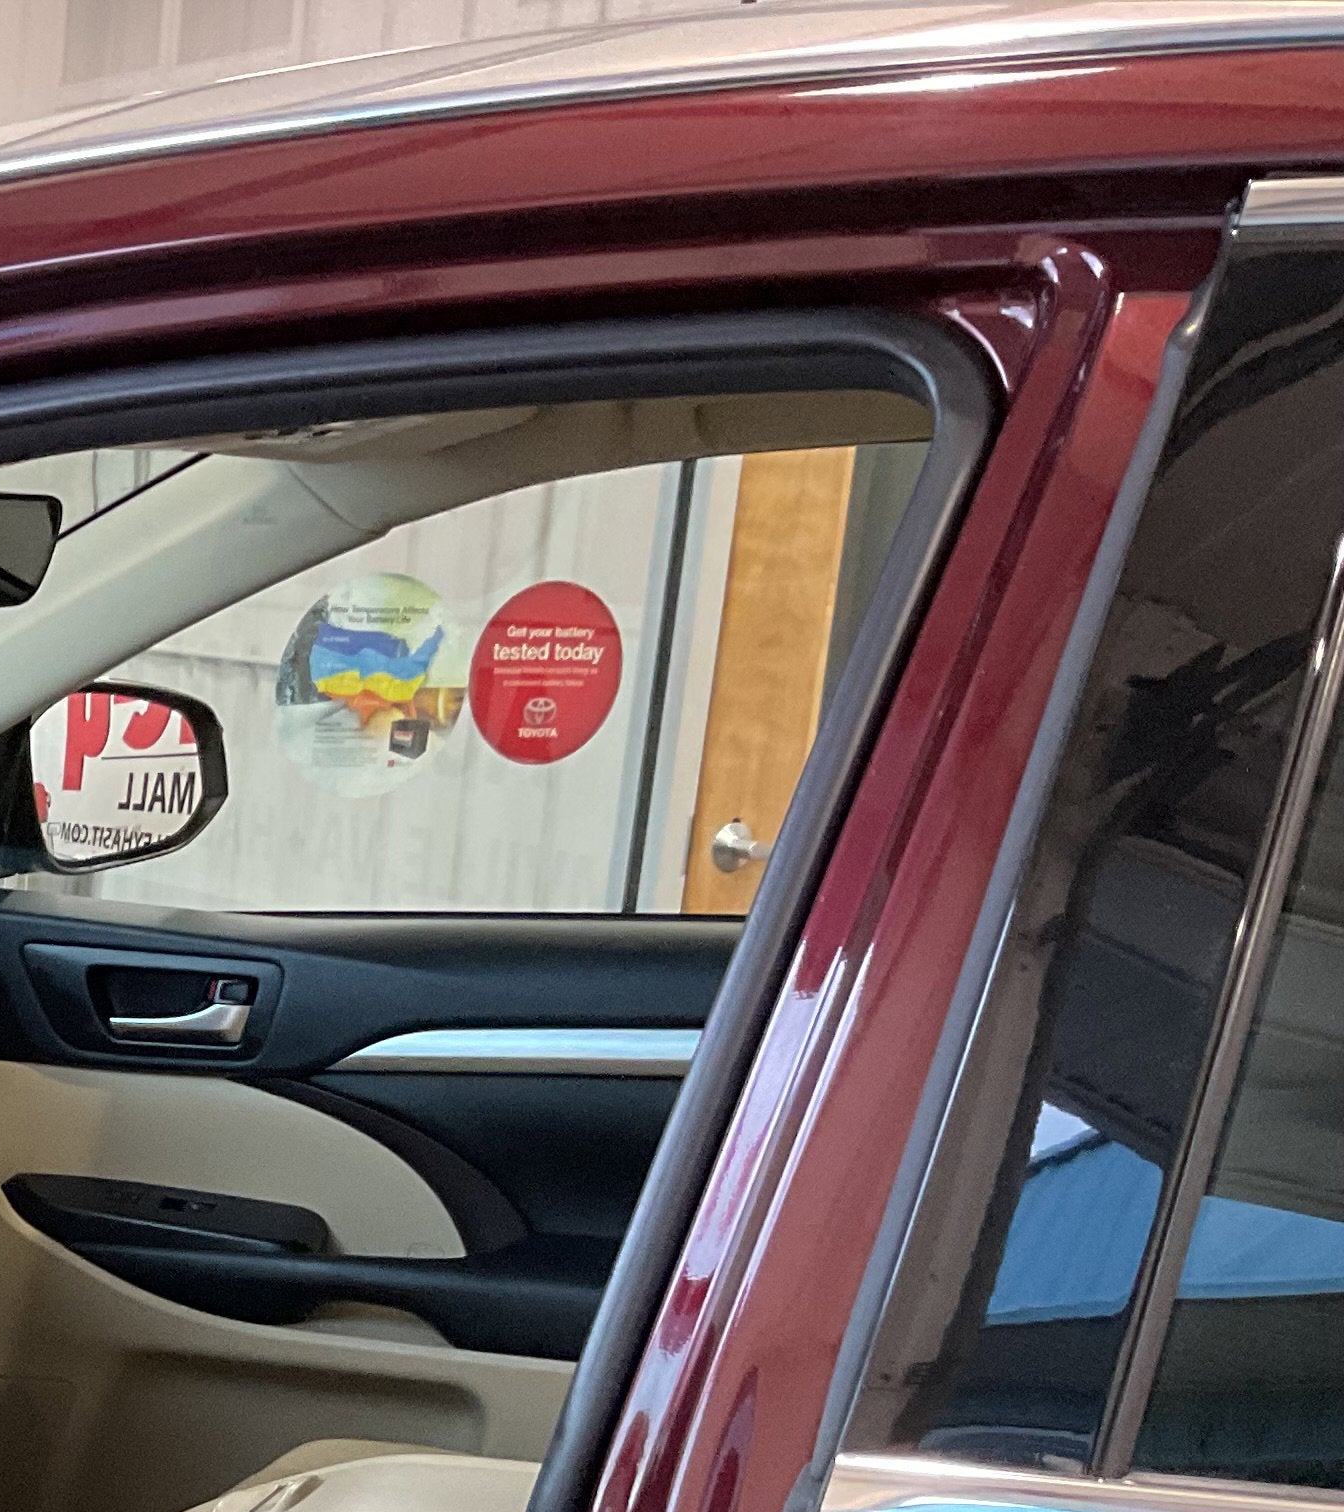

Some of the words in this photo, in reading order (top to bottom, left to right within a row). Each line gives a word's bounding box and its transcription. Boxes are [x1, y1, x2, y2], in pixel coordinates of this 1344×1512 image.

[506, 625, 527, 637] Get
[528, 628, 553, 640] your
[555, 627, 595, 640] battery
[493, 642, 550, 661] tested
[554, 642, 604, 665] today
[518, 727, 558, 738] TOYOTA
